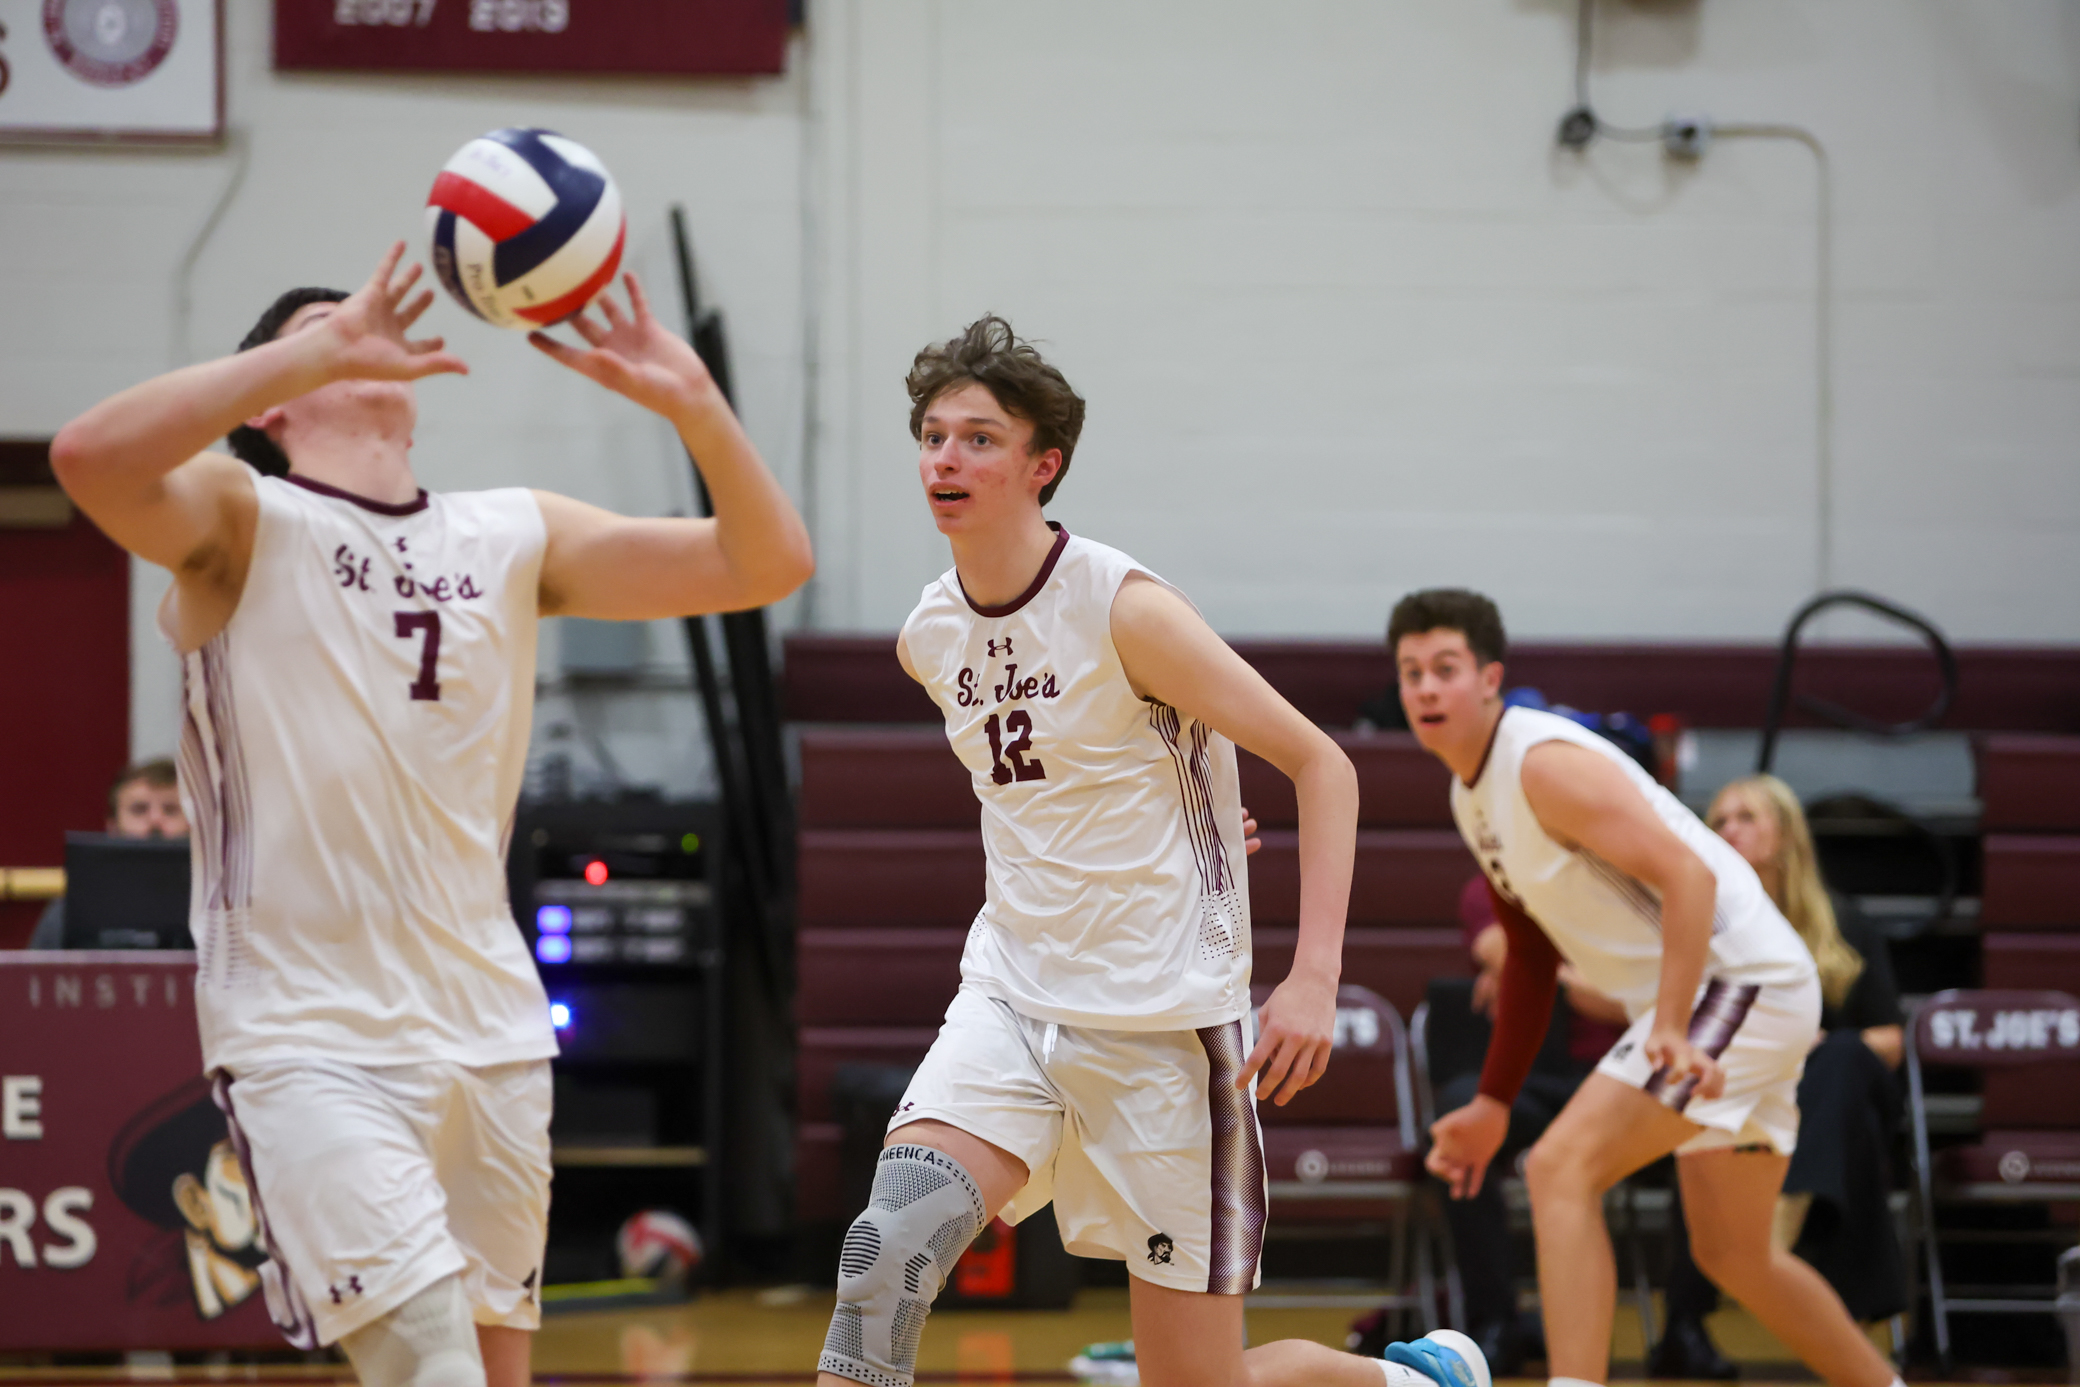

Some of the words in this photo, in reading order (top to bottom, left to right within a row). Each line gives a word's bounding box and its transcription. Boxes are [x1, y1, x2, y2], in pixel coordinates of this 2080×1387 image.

[394, 610, 441, 701] 7
[994, 663, 1060, 703] Joe's
[984, 709, 1047, 786] 12
[28, 973, 196, 1009] INSTI
